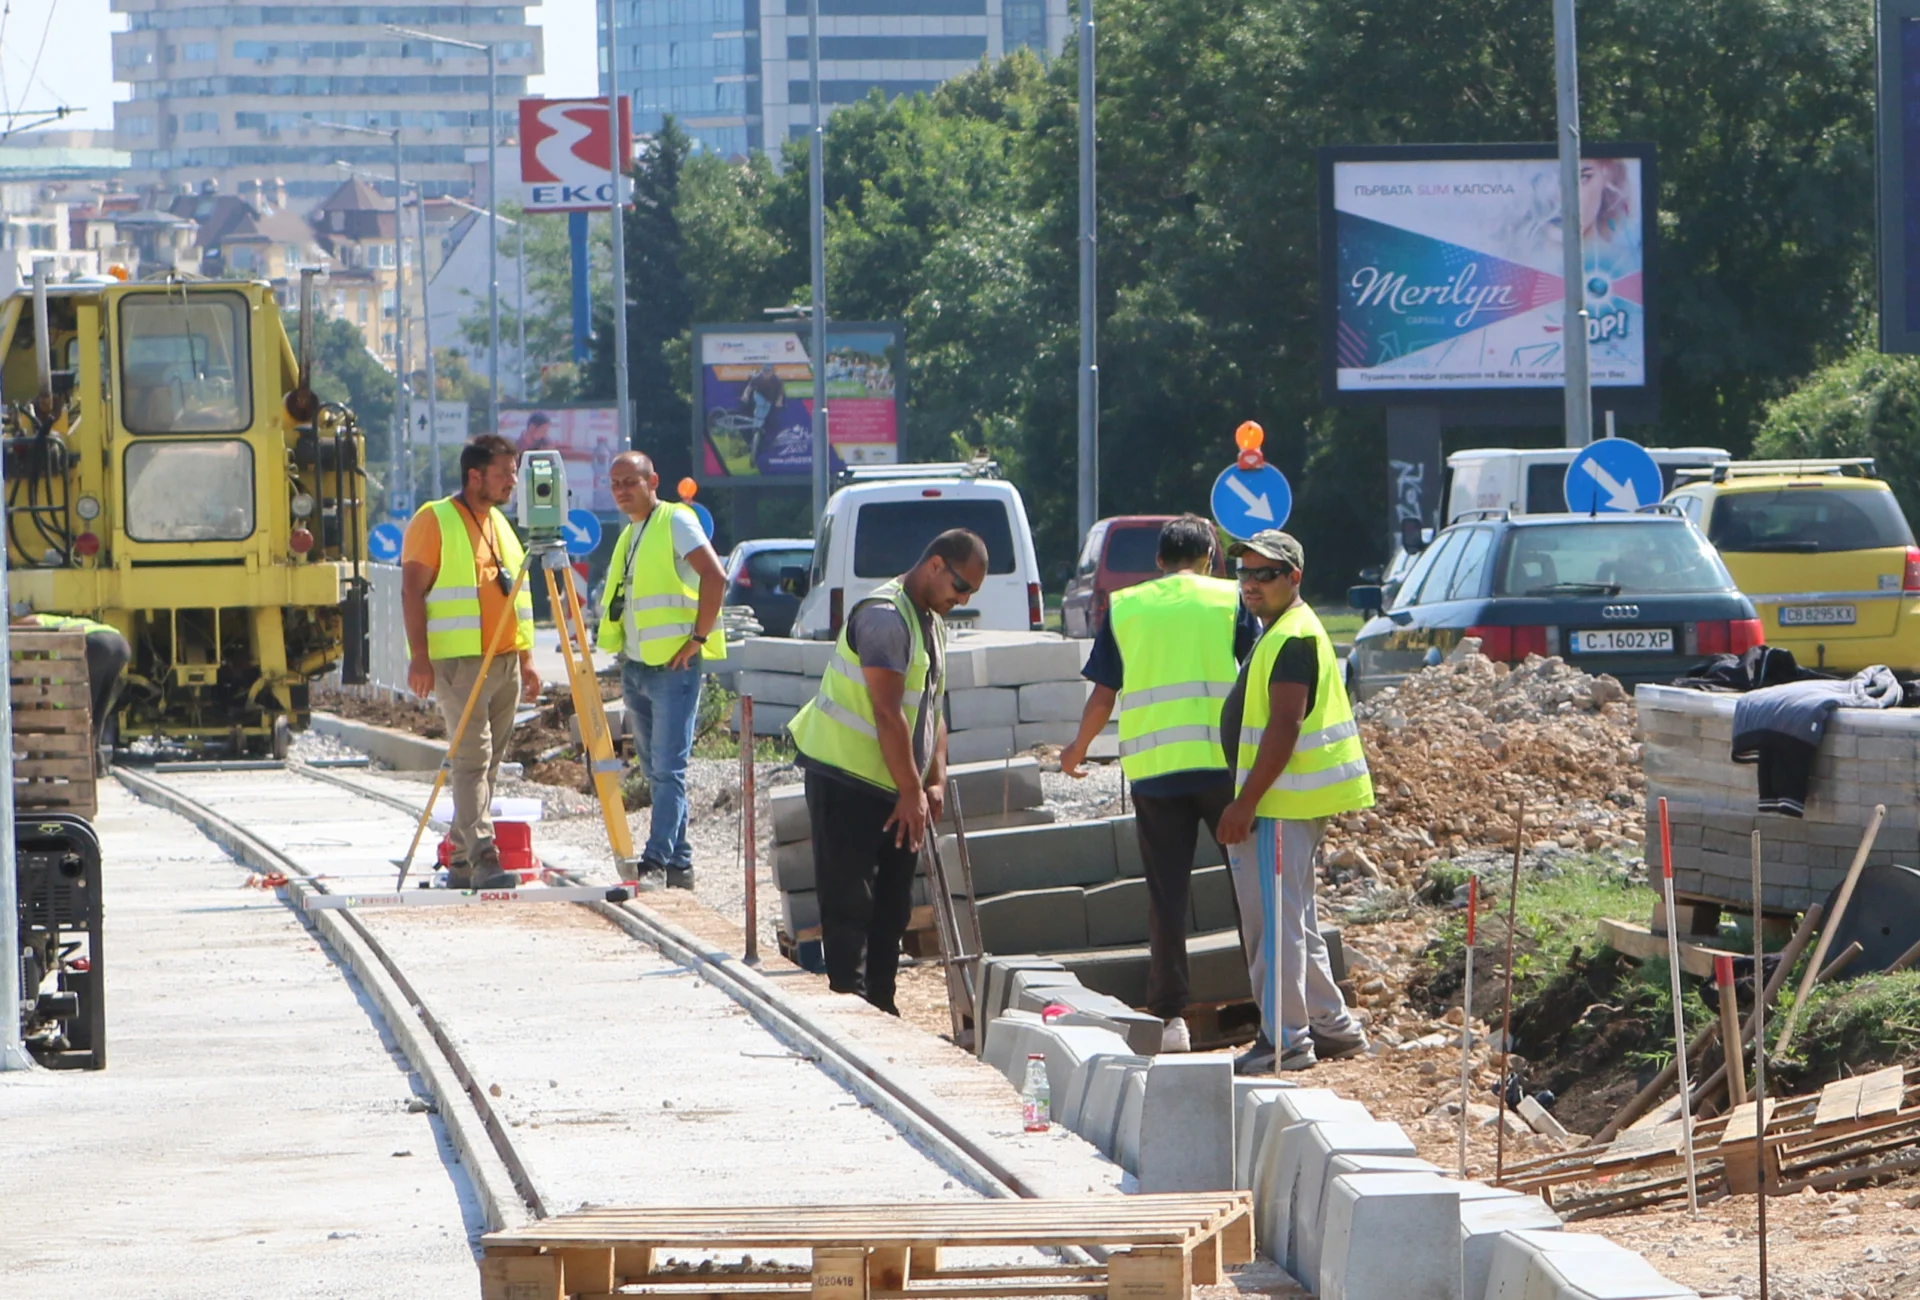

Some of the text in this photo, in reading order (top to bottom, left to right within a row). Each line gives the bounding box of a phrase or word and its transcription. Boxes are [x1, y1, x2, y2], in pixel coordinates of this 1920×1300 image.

[1354, 183, 1515, 197] ПЪРВАТА SLIM КАПСУЛА
[1351, 262, 1523, 328] Merilyn
[1587, 311, 1627, 340] OP!
[1805, 607, 1835, 621] 8295
[1586, 630, 1670, 649] C 1602 XP
[818, 1275, 854, 1287] 020418
